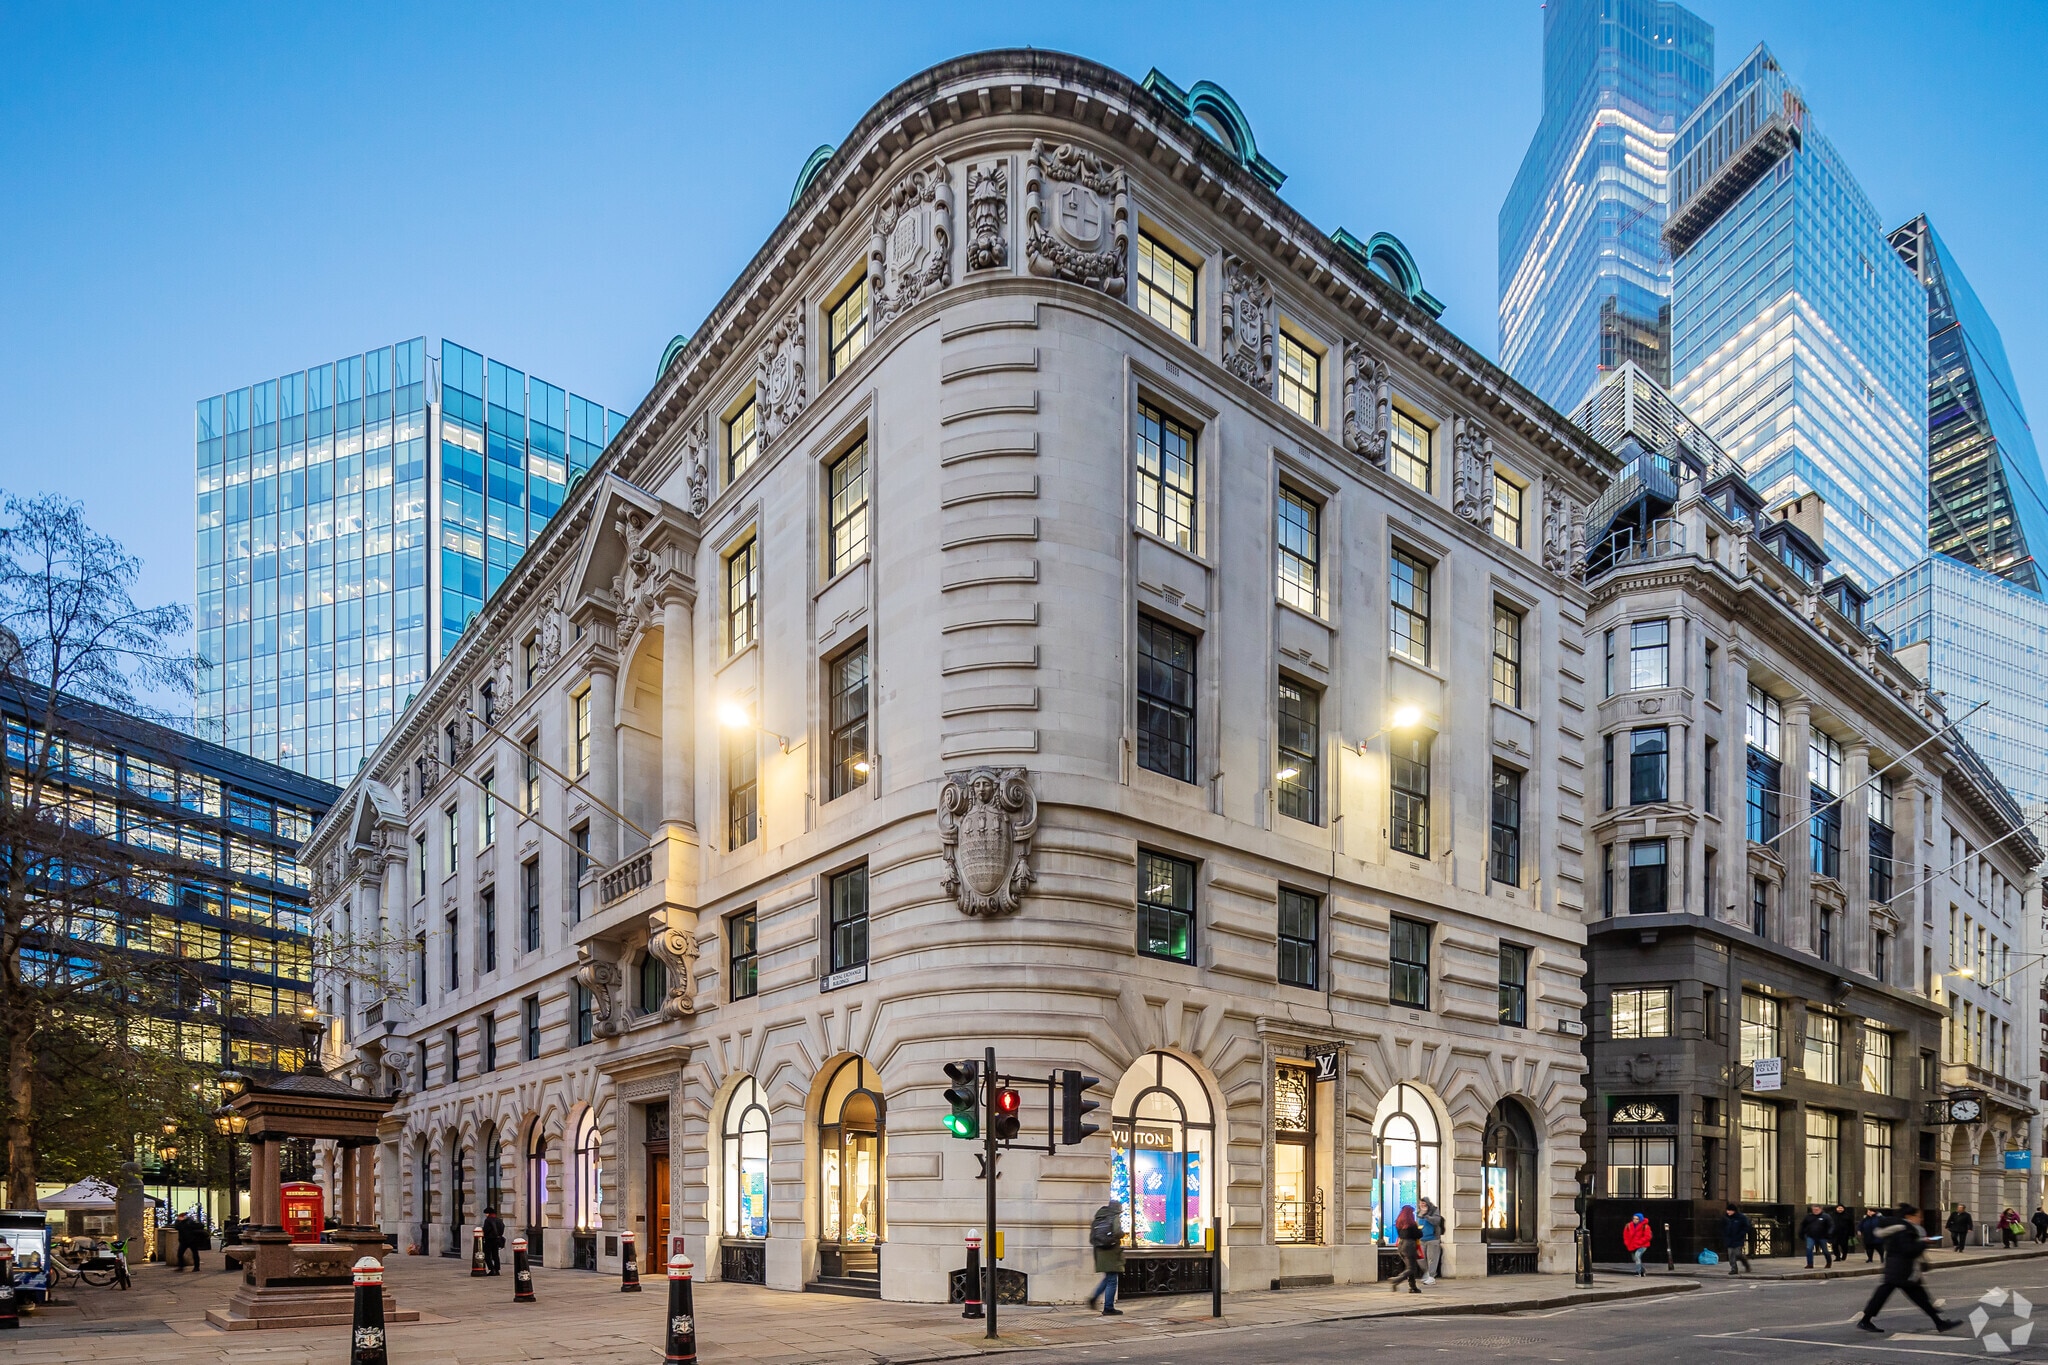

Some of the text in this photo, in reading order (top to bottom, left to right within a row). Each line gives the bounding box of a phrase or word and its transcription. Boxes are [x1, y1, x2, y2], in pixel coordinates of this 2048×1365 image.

[1608, 1126, 1677, 1134] UNION BUILDING
[1112, 1131, 1164, 1145] VUTTON
